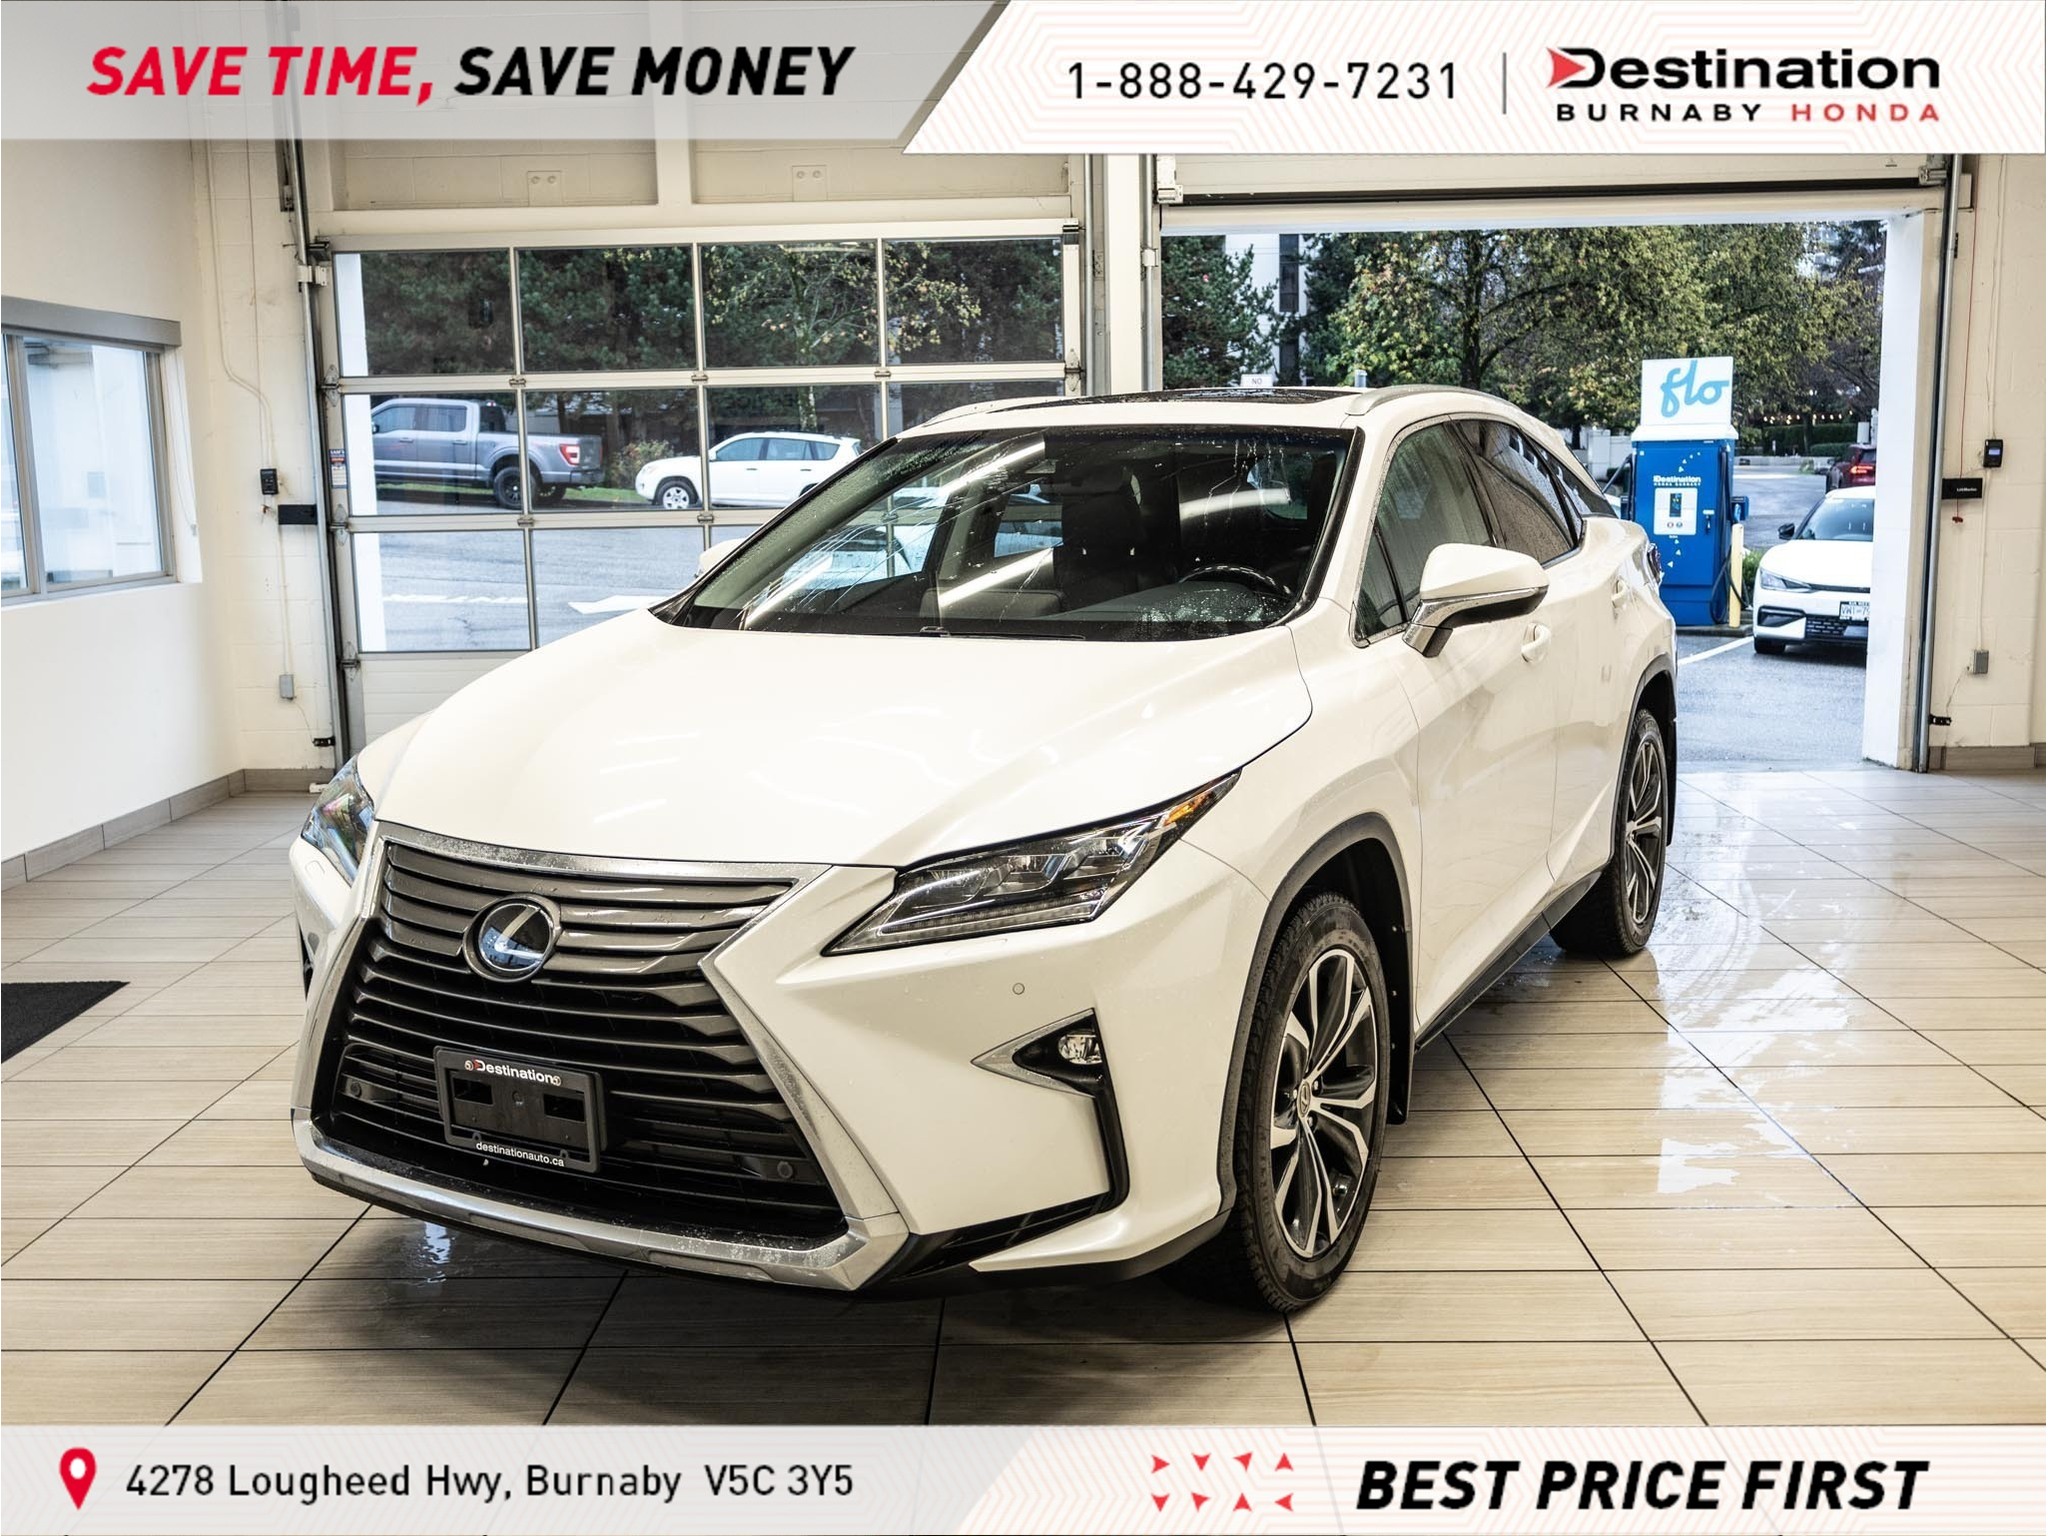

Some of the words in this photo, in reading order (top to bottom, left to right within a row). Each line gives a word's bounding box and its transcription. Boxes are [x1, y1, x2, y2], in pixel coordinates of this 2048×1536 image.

[1660, 359, 1730, 418] flo
[473, 1059, 555, 1084] Destination
[476, 1141, 565, 1167] destinationauto.ca
